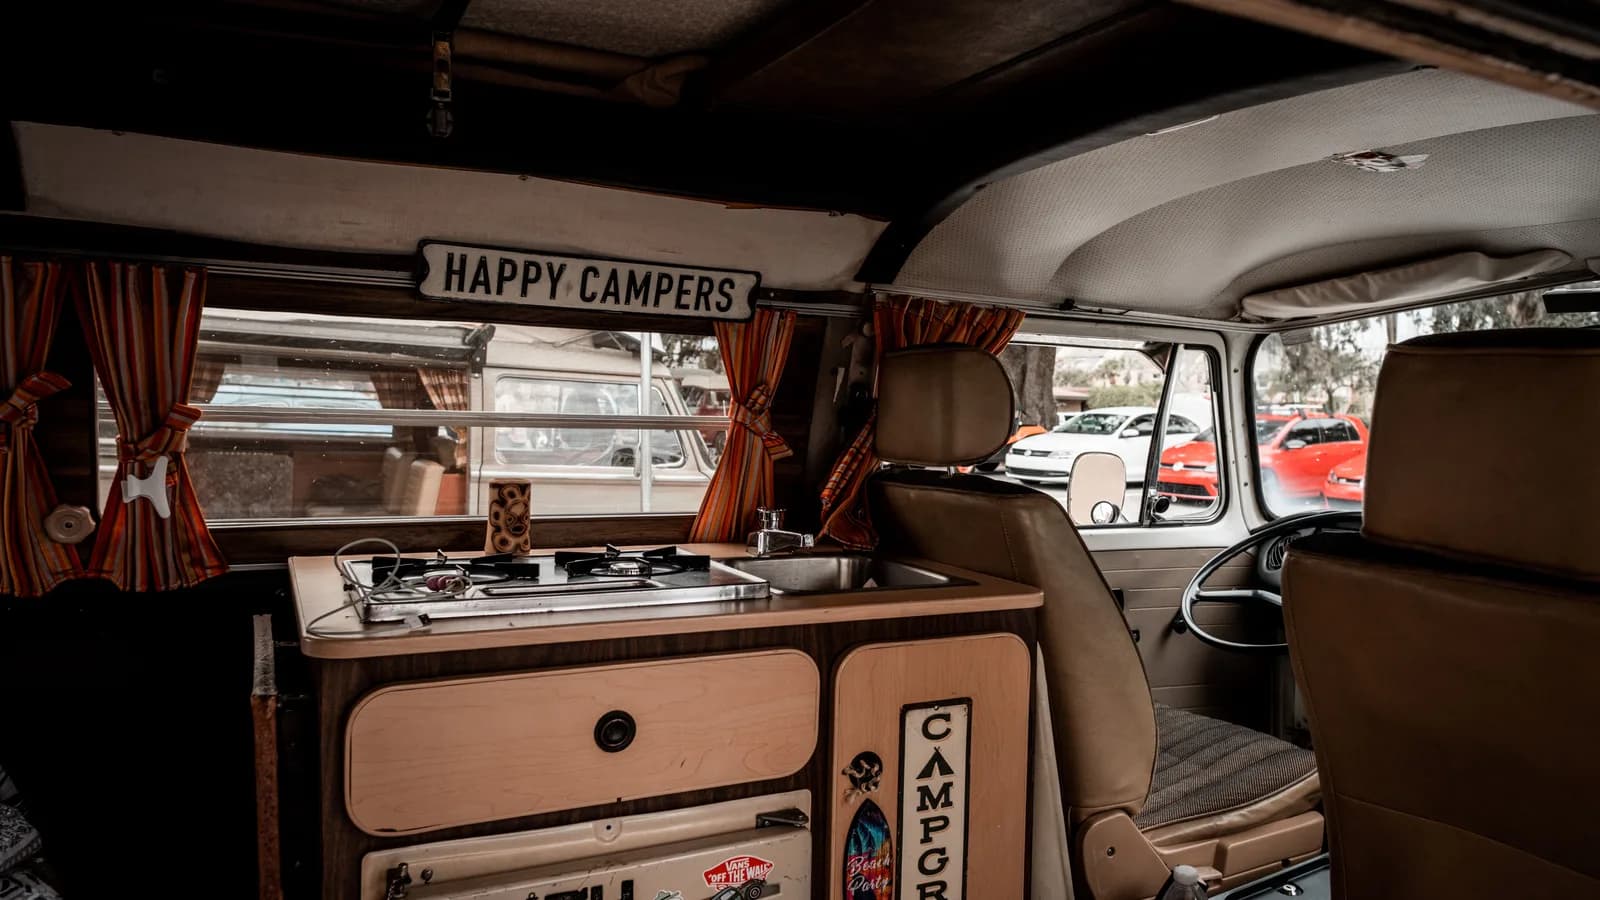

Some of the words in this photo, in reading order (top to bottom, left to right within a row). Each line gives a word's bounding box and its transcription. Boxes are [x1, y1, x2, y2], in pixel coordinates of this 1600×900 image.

[445, 252, 567, 300] HAPPY
[580, 266, 736, 312] CAMPERS
[725, 858, 750, 872] VANS
[847, 854, 891, 877] Beach
[728, 868, 746, 882] THE
[847, 876, 889, 895] Party
